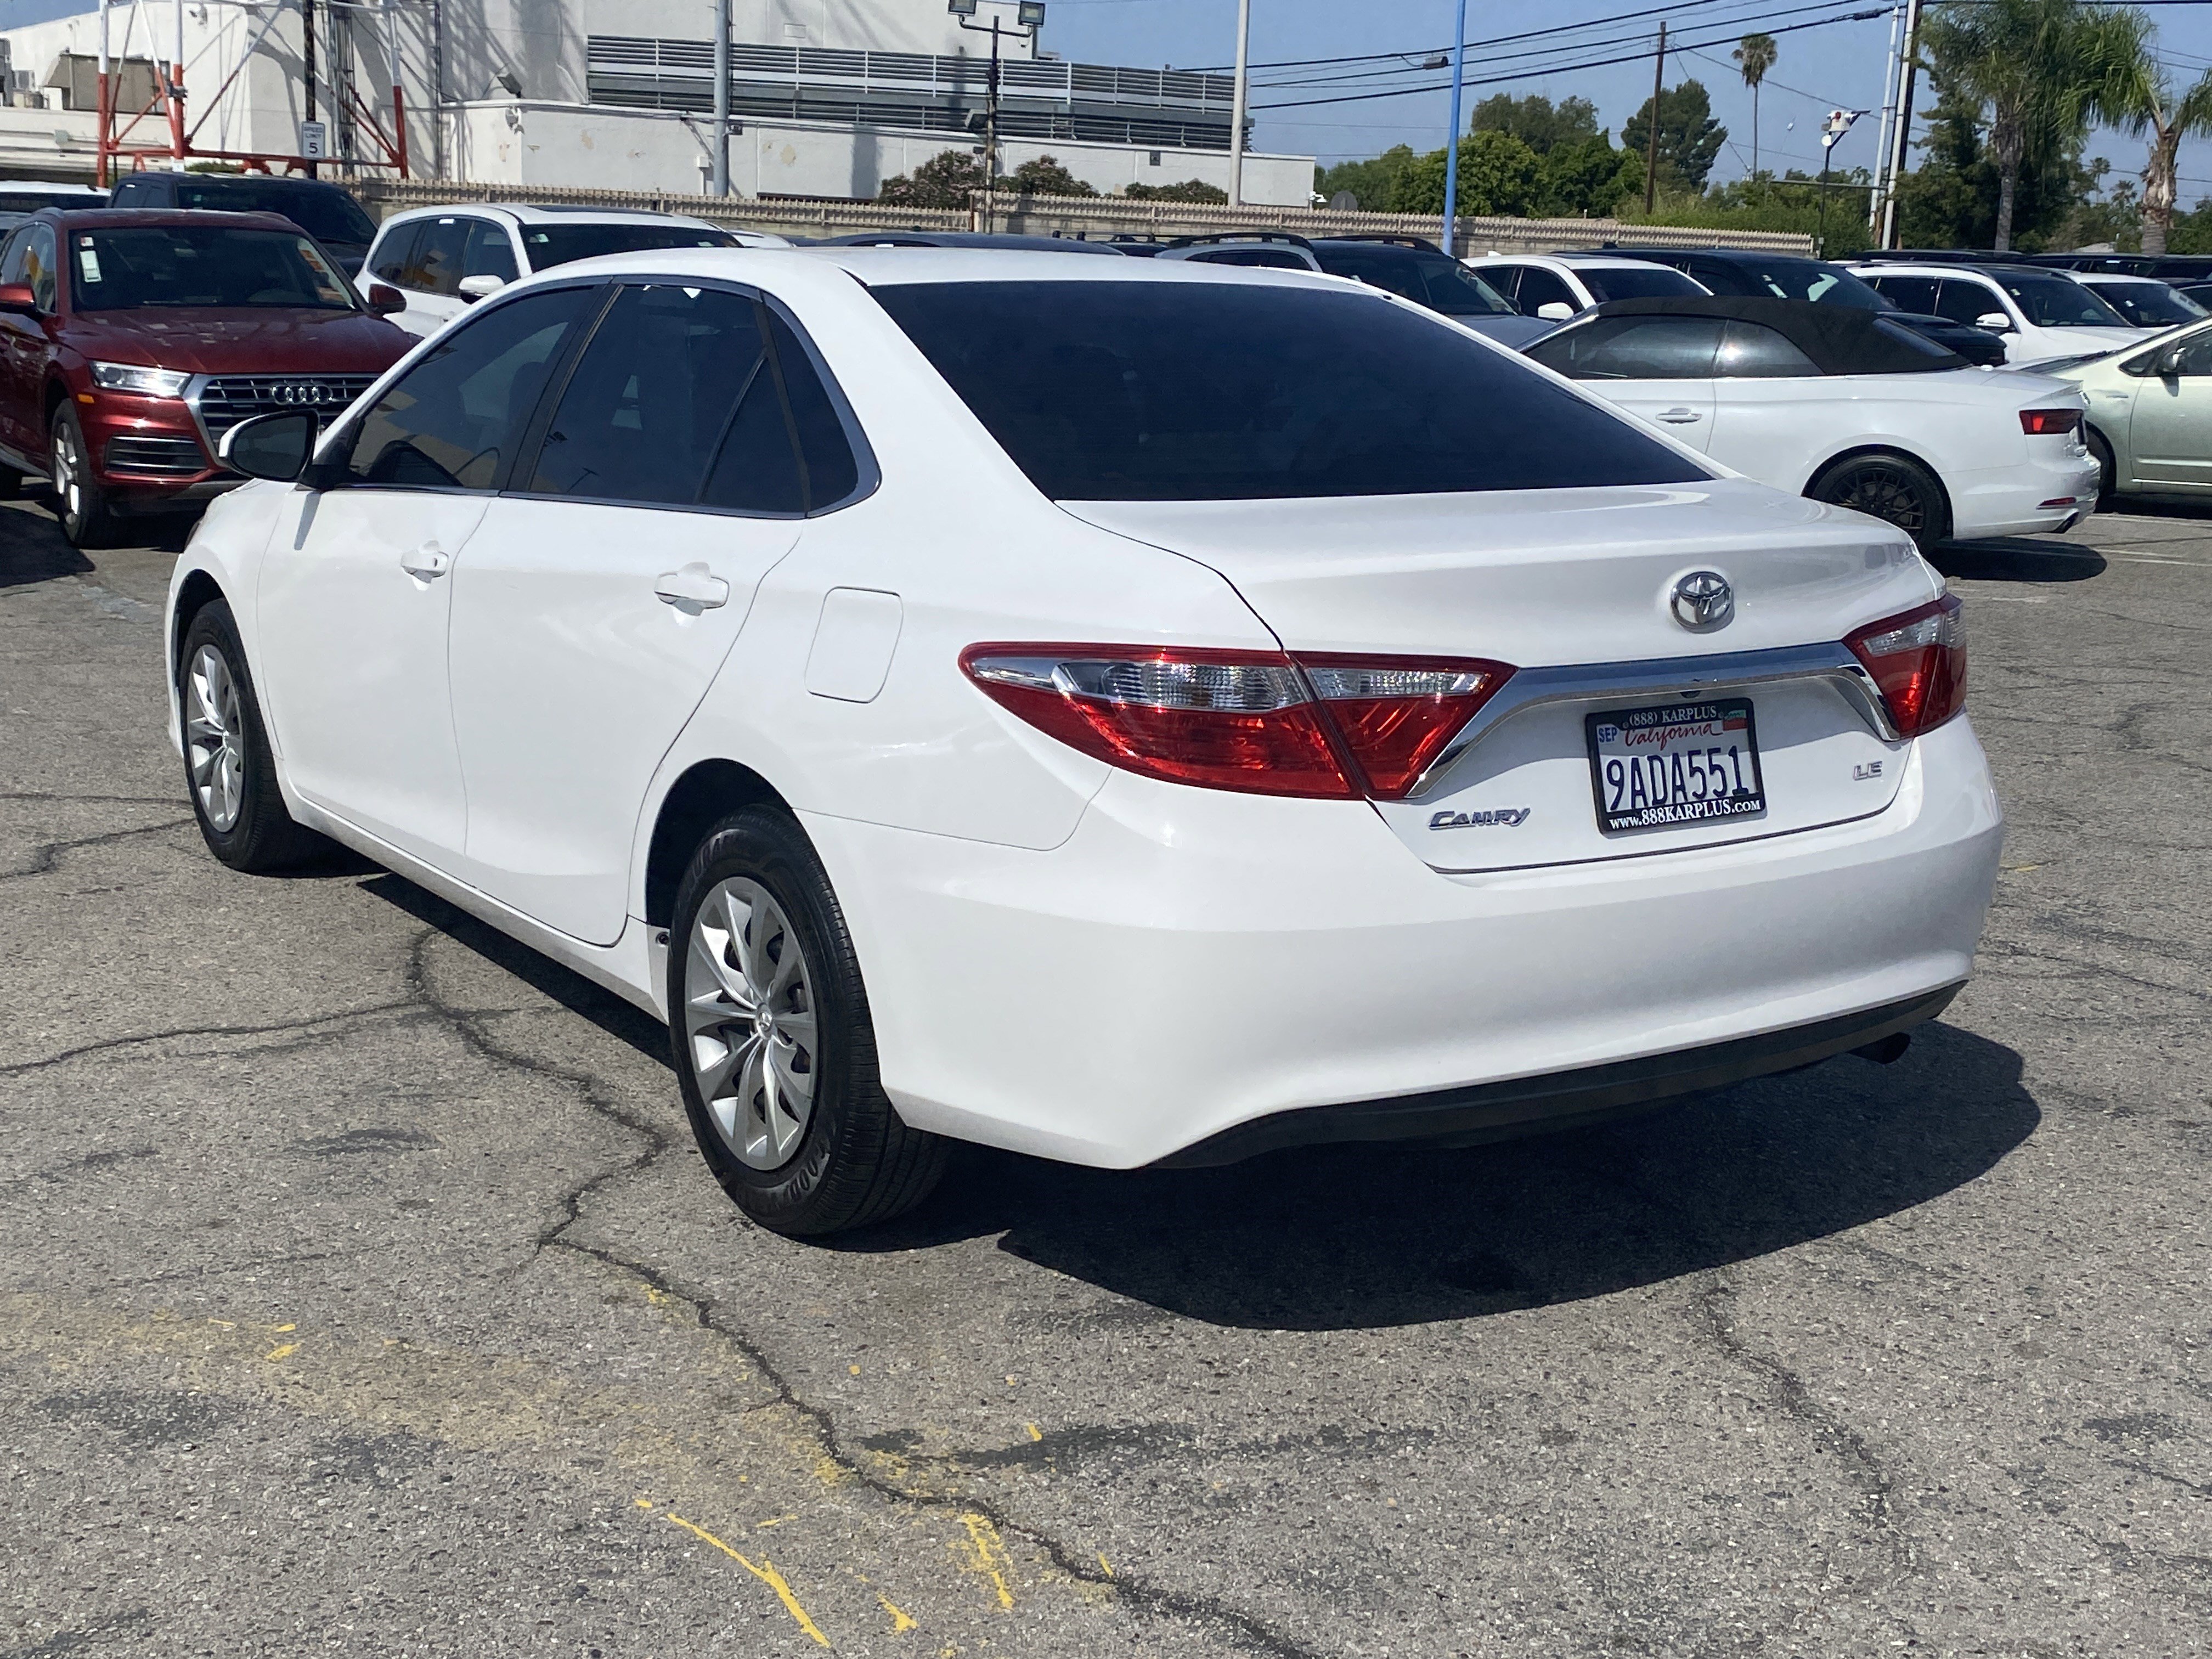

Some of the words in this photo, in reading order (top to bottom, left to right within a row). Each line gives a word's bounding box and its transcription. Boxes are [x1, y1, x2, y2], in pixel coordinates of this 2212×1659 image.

[309, 142, 318, 154] 5
[1629, 712, 1657, 726] (888)
[1662, 706, 1717, 723] KARPLUS
[1598, 727, 1618, 743] SEP
[1624, 723, 1723, 751] California
[1606, 746, 1749, 811] 9ADA551
[1853, 760, 1883, 781] LE
